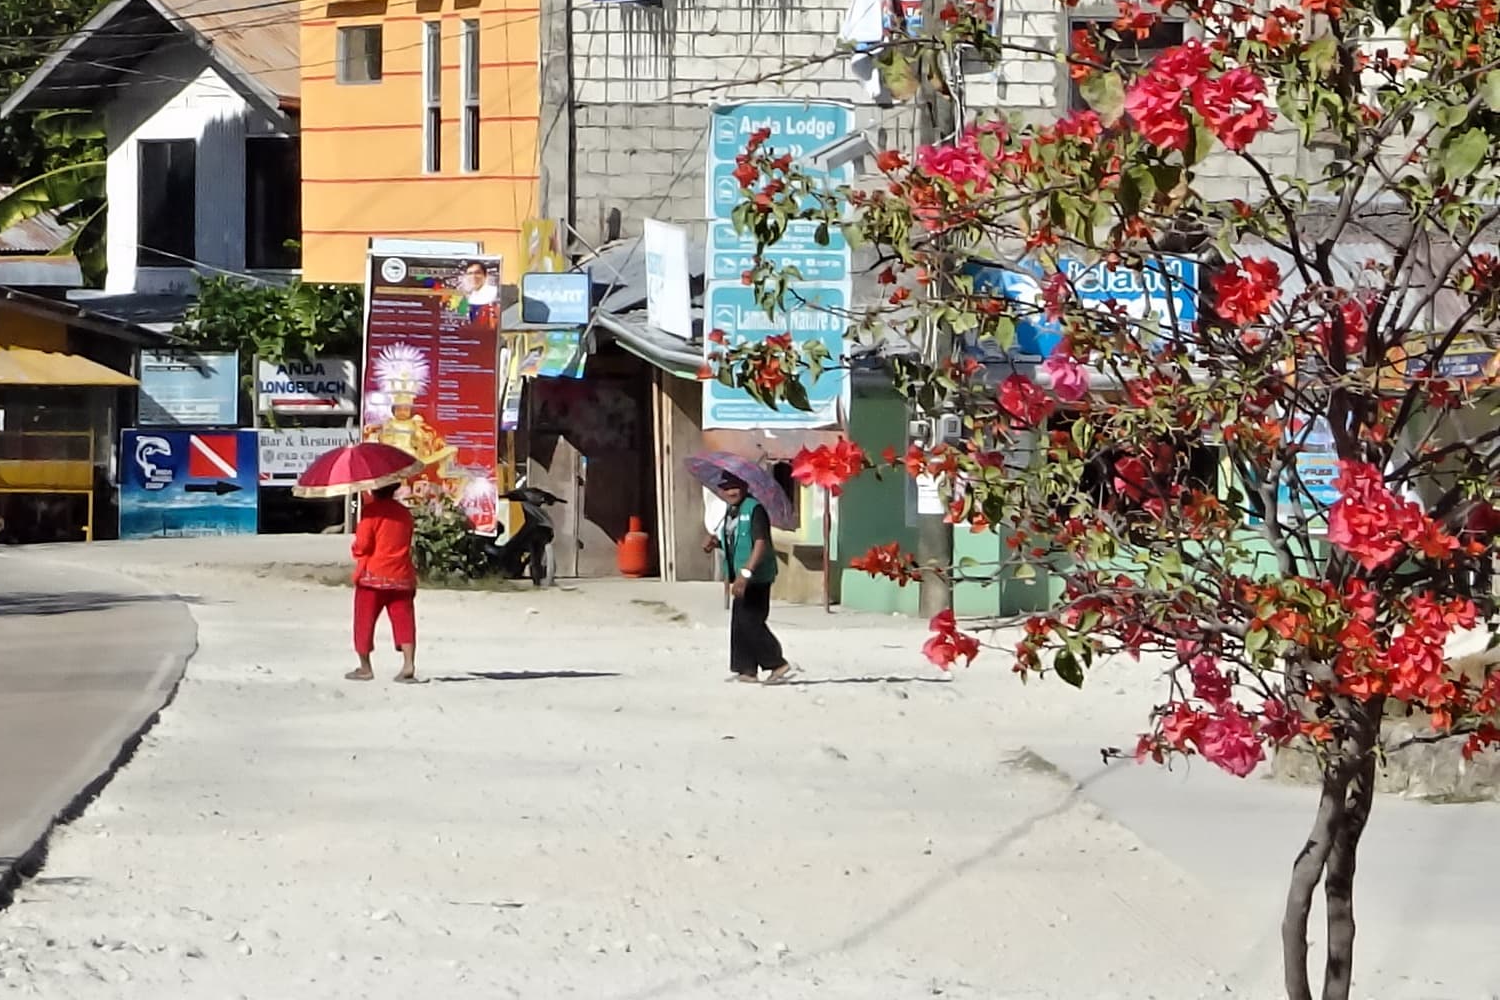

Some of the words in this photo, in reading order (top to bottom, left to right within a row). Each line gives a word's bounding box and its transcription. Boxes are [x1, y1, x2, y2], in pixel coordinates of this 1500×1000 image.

[786, 115, 836, 139] Lodge
[276, 362, 326, 376] ANDA
[260, 381, 346, 394] LONGBEACH
[260, 436, 280, 447] Bar
[285, 436, 294, 447] &
